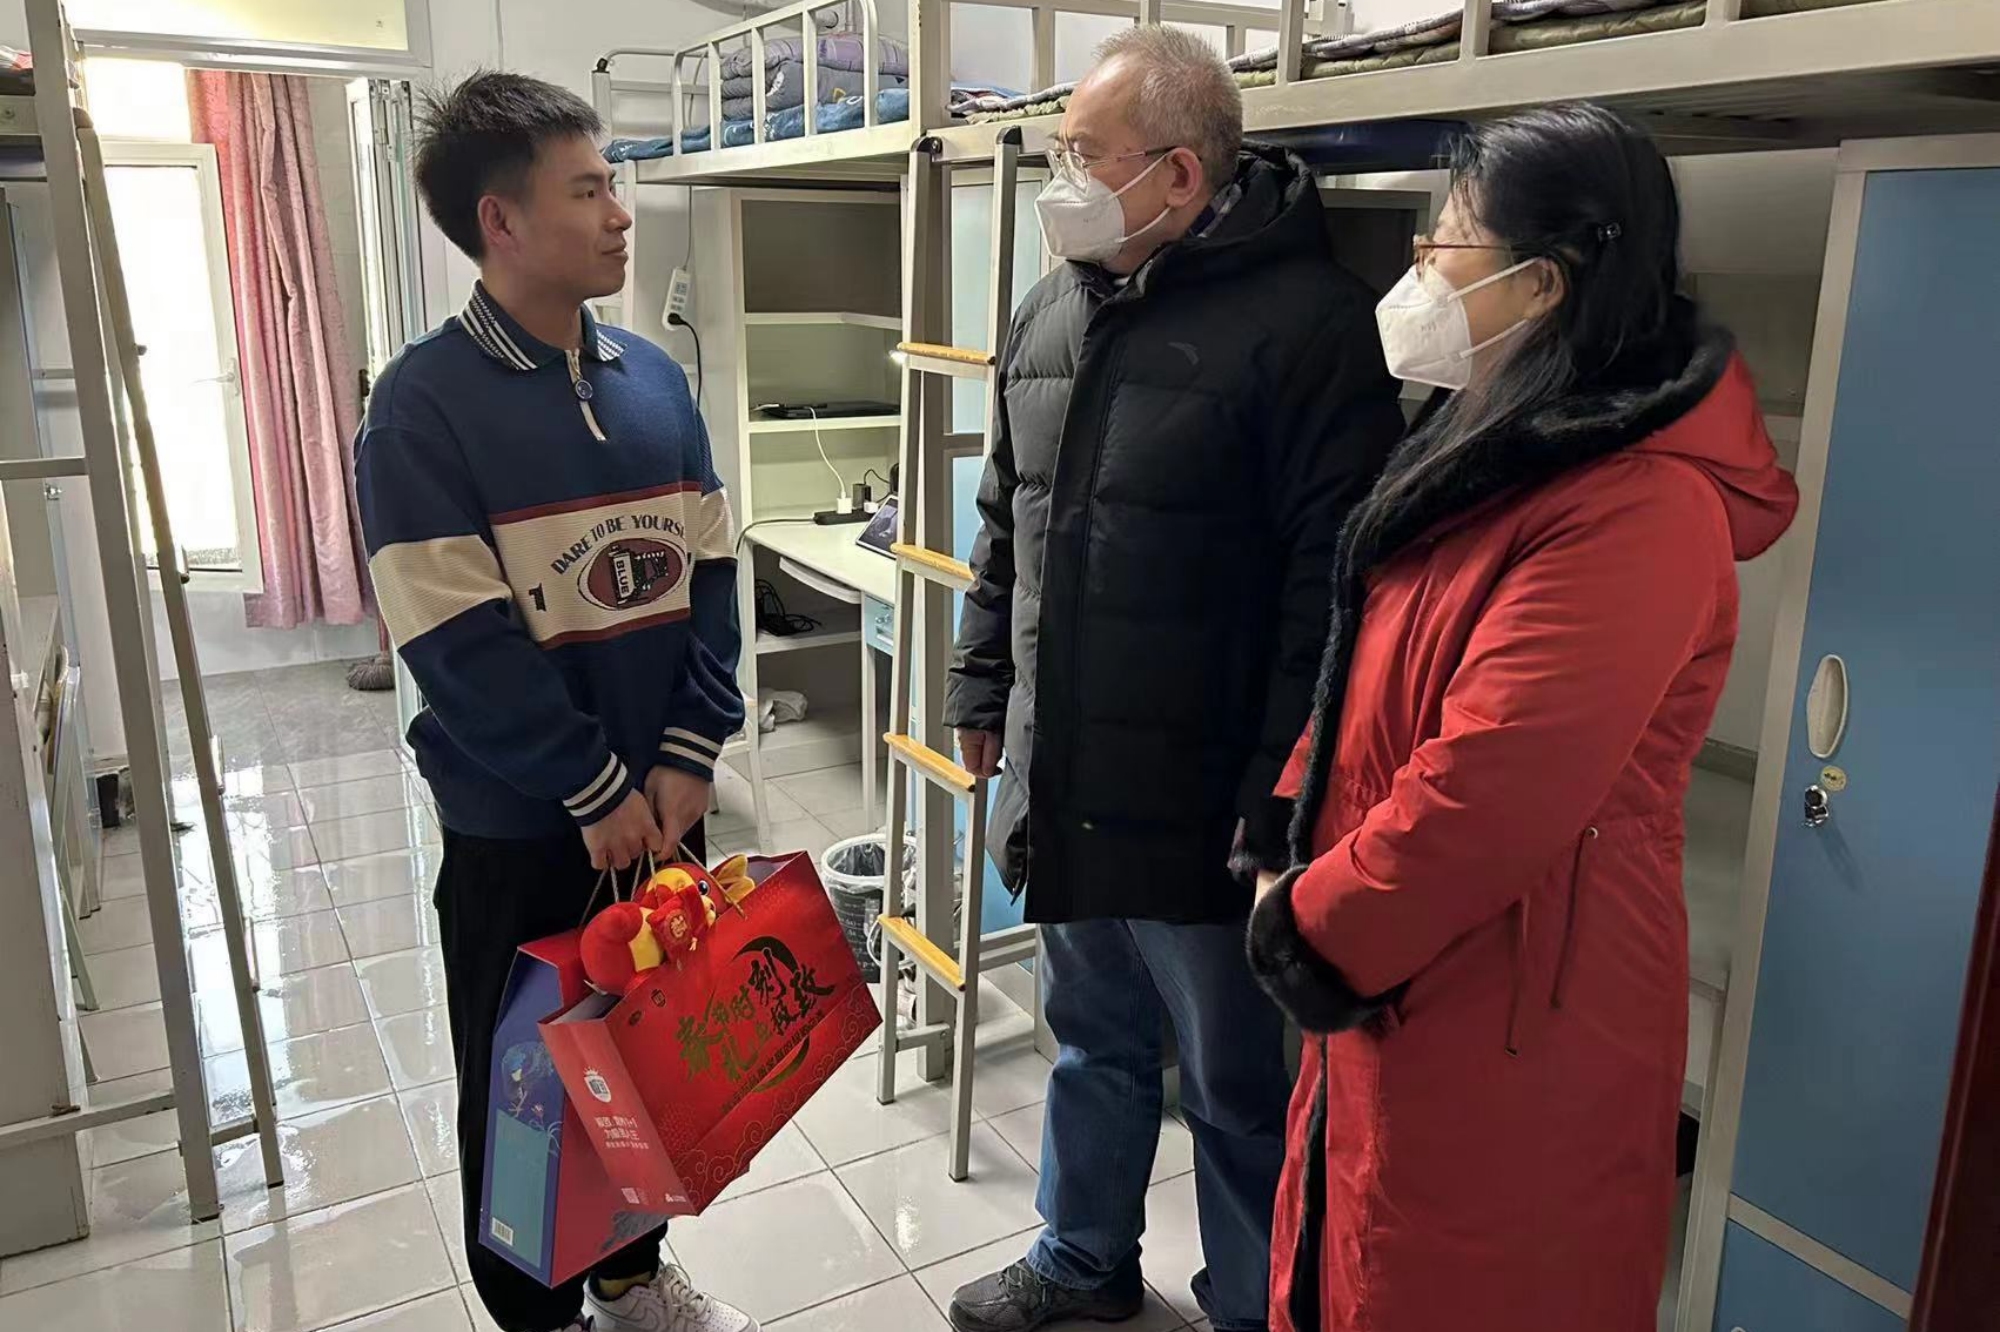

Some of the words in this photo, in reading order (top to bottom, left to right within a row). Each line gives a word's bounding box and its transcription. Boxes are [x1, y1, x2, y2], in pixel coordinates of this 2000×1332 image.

[550, 534, 593, 574] DARE
[590, 523, 606, 541] TO
[605, 515, 627, 534] BE
[616, 559, 630, 594] BLUE
